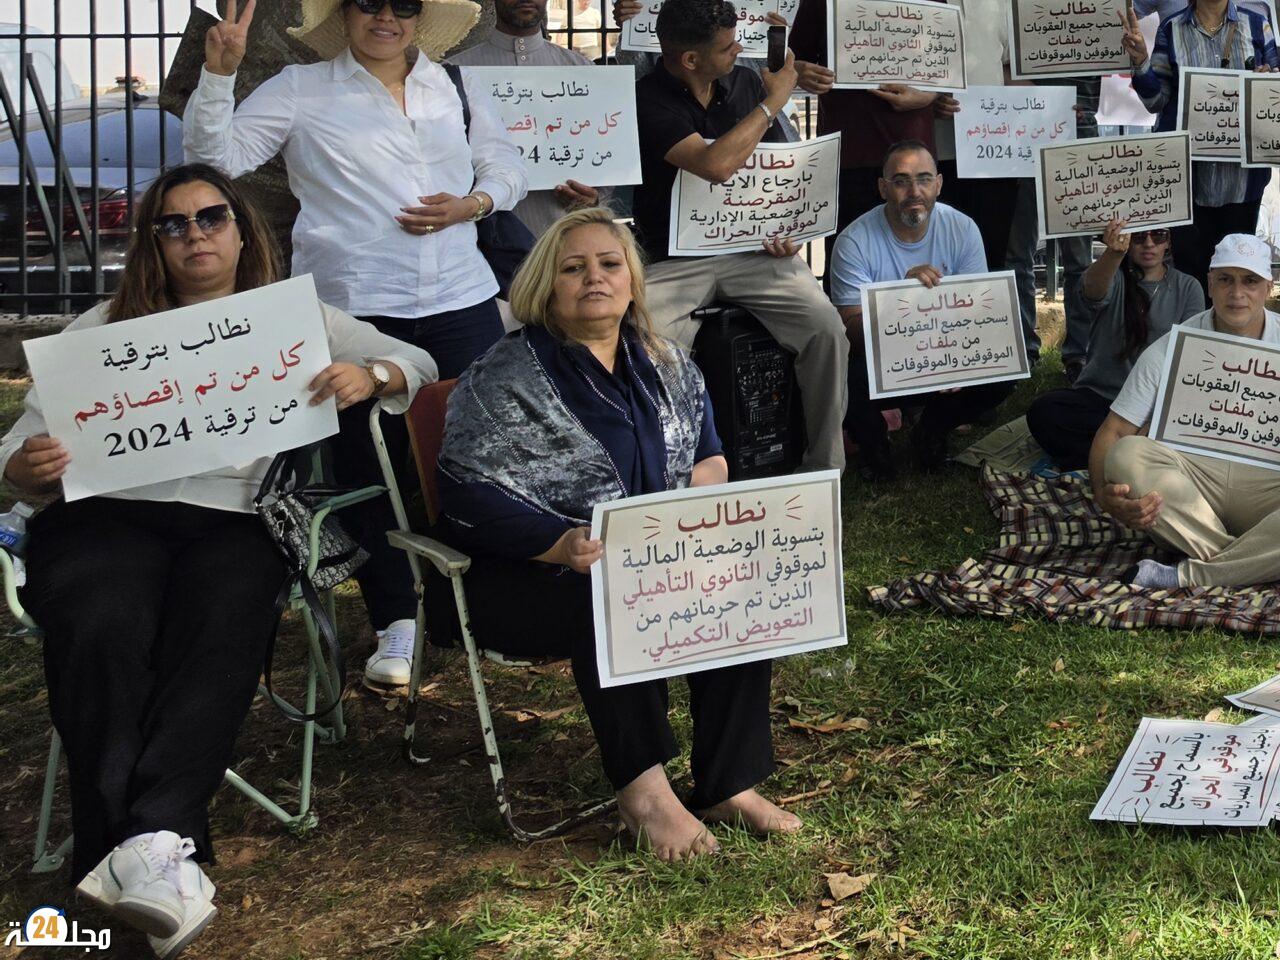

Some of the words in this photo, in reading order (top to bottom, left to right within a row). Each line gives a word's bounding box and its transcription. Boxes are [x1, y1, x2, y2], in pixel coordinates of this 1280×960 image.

[876, 6, 922, 21] نطالب
[845, 20, 880, 34] المالية
[885, 22, 923, 38] الوضعية
[927, 25, 955, 41] بتسوية
[844, 34, 884, 52] التأهيلي
[888, 38, 920, 53] الثانوي
[924, 42, 956, 54] لموقوفي
[851, 53, 865, 64] من
[869, 53, 908, 65] حرمانهم
[912, 56, 922, 67] تم
[925, 57, 949, 67] الذين
[853, 66, 902, 80] التكميلي.
[906, 69, 948, 80] التعويض
[493, 83, 532, 104] بترقية
[542, 82, 589, 103] نطالب
[545, 118, 562, 139] تم
[570, 121, 590, 135] من
[598, 112, 622, 134] كل
[549, 146, 584, 167] ترقية
[592, 152, 612, 165] من
[762, 171, 812, 192] بارجاع
[723, 188, 805, 209] المقرصنة
[813, 200, 828, 213] من
[690, 210, 743, 226] الإدارية
[749, 203, 809, 223] الوضعية
[705, 225, 761, 241] الحراك
[766, 215, 817, 239] لموقوفي
[917, 292, 973, 316] نطالب
[885, 318, 937, 337] العقوبات
[941, 319, 971, 334] جميع
[974, 314, 1008, 329] بسحب
[180, 318, 251, 355] نطالب
[916, 336, 957, 351] ملفات
[962, 335, 980, 349] من
[101, 341, 168, 371] بترقية
[272, 341, 304, 381] كل
[887, 355, 957, 373] والموقوفات.
[962, 347, 1013, 366] الموقوفين
[195, 372, 216, 404] تم
[231, 364, 260, 391] من
[1182, 373, 1240, 394] العقوبات
[74, 380, 184, 431] إقصاؤهم
[1241, 387, 1276, 404] جميع
[269, 399, 298, 424] من
[1209, 398, 1254, 417] ملفات
[206, 406, 256, 436] ترقية
[1173, 412, 1249, 439] والموقوفات.
[1258, 413, 1279, 424] من
[105, 417, 192, 457] 2024
[678, 500, 766, 539] نطالب
[693, 530, 765, 563] الوضعية
[772, 527, 824, 552] بتسوية
[622, 541, 685, 572] المالية
[766, 552, 826, 583] لموقوفي
[700, 561, 759, 596] الثانوي
[623, 571, 693, 609] التأهيلي
[769, 581, 811, 609] الذين
[669, 598, 739, 629] حرمانهم
[744, 590, 762, 616] تم
[637, 613, 661, 631] من
[736, 608, 813, 642] التعويض
[643, 623, 729, 662] التكميلي.
